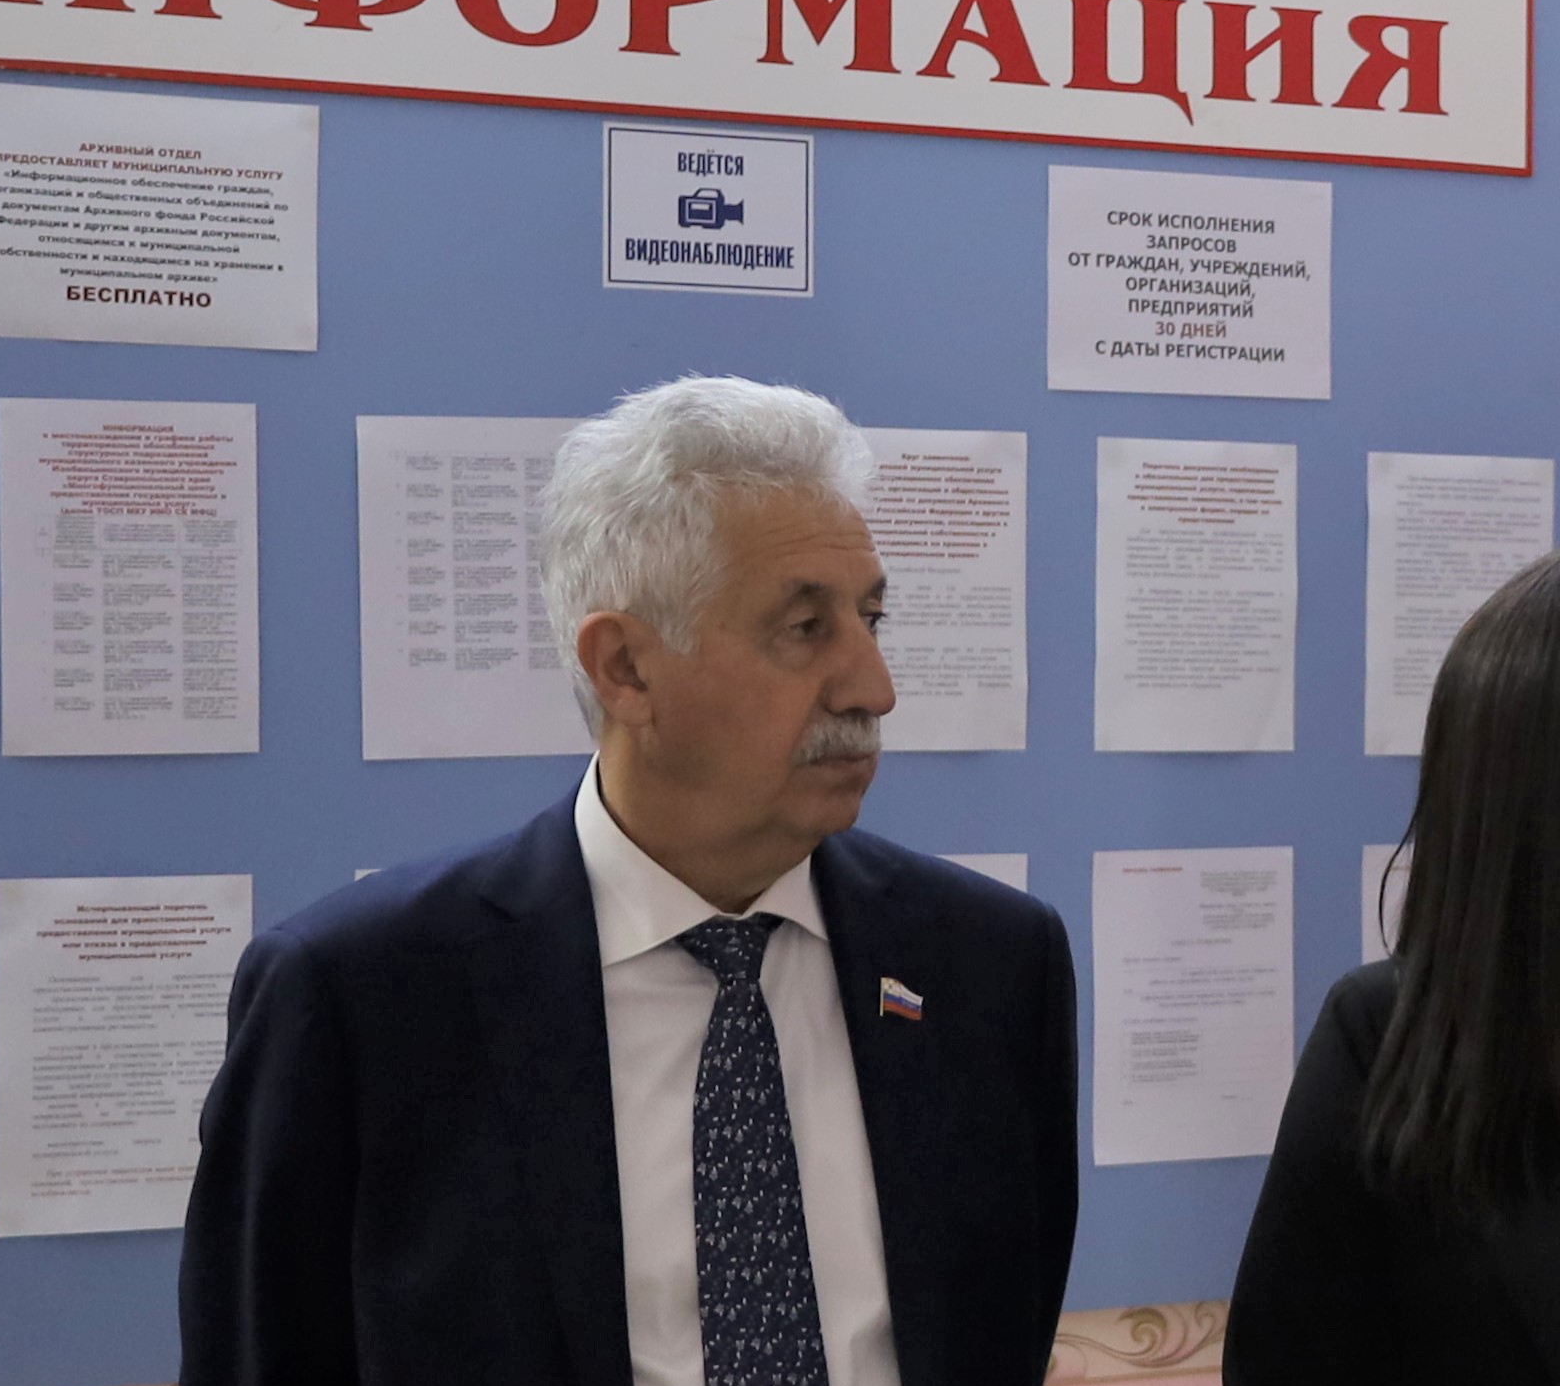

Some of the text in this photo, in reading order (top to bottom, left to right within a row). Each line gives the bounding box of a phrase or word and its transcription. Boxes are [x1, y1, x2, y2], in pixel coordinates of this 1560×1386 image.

[80, 143, 201, 160] АРХИВНЫЙ ОТДЕЛ
[113, 162, 233, 177] МУНИЦИПАЛЬНУЮ
[236, 169, 283, 181] УСЛУГУ
[678, 149, 744, 176] ВЕДЁТСЯ
[4, 169, 274, 196] «Информационное обеспечение граждан,
[88, 192, 182, 205] общественных
[186, 197, 269, 210] объединений
[2, 201, 274, 225] документам Архивного фонда Российской
[1108, 211, 1274, 233] СРОК ИСПОЛНЕНИЯ
[84, 223, 129, 232] другим
[133, 226, 198, 236] архивным
[202, 229, 280, 242] документам,
[39, 235, 125, 247] относящимся
[140, 242, 240, 253] муниципальной
[1147, 235, 1236, 253] ЗАПРОСОВ
[104, 254, 190, 267] находящимся
[214, 261, 273, 271] хранении
[626, 238, 794, 270] ВИДЕОНАБЛЮДЕНИЕ
[60, 267, 163, 281] муниципальном
[1068, 253, 1310, 280] ОТ ГРАЖДАН, УЧРЕЖДЕНИЙ,
[67, 286, 211, 308] БЕСПЛАТНО
[1126, 277, 1256, 299] ОРГАНИЗАЦИЙ,
[1129, 299, 1252, 318] ПРЕДПРИЯТИЙ
[1156, 321, 1226, 339] 30 ДНЕЙ
[1096, 341, 1284, 363] С ДАТЫ РЕГИСТРАЦИИ
